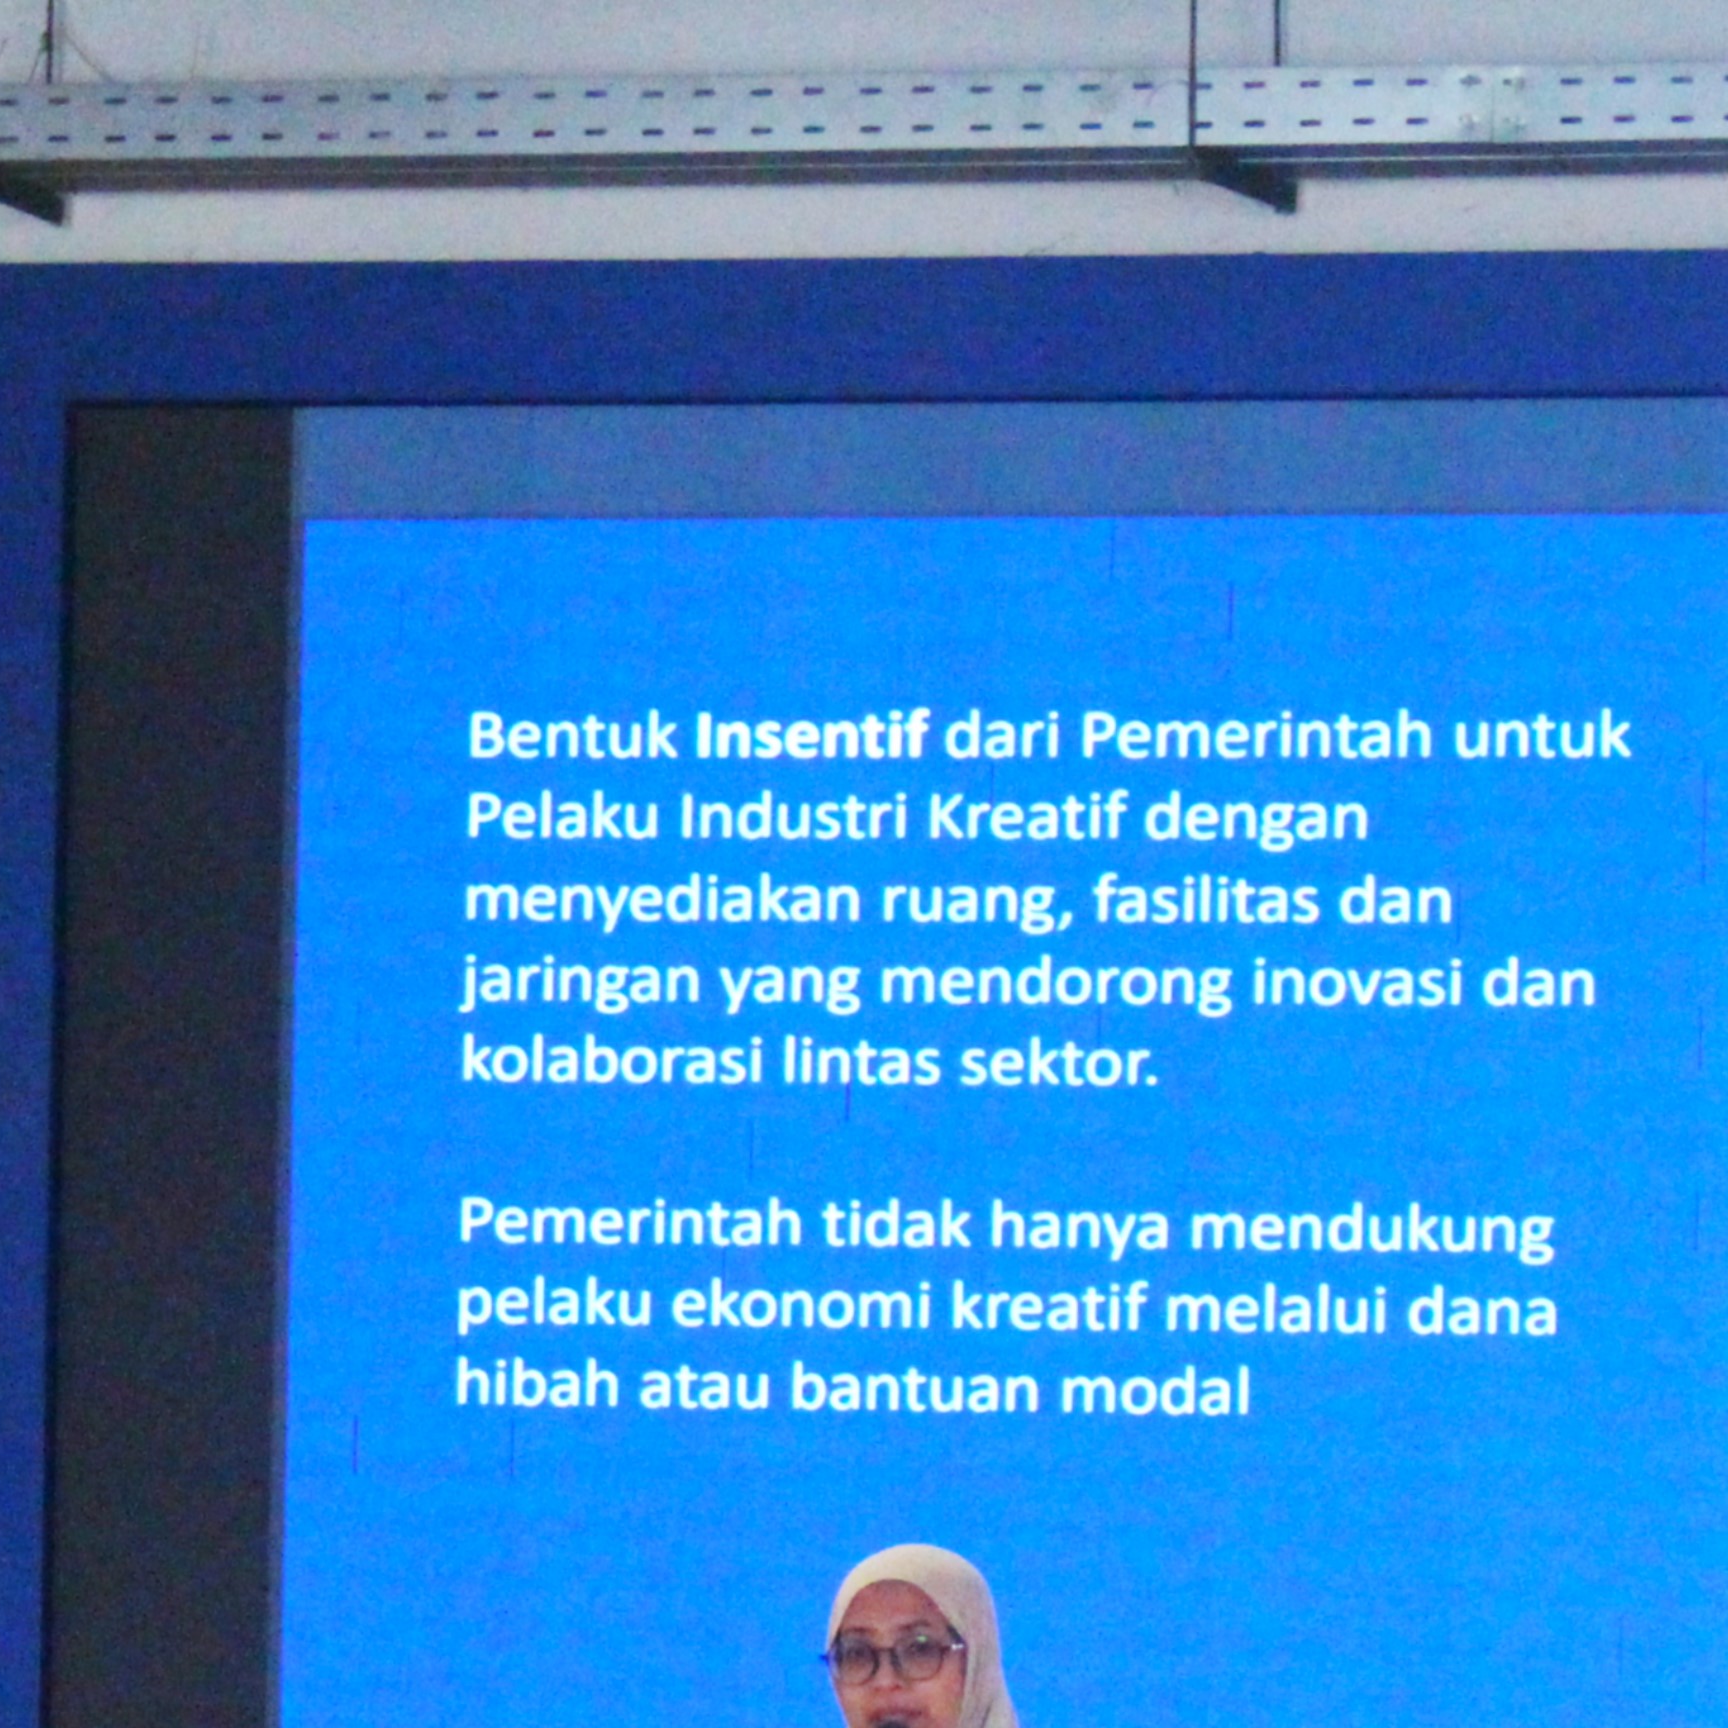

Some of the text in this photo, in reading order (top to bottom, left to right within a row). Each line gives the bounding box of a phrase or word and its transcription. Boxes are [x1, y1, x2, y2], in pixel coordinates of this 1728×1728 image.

[470, 707, 1632, 760] Bentuk Insentif dari Pemerintah untuk
[469, 788, 1368, 853] Pelaku Industri Kreatif dengan
[466, 872, 1452, 935] menyediakan ruang, fasilitas dan
[459, 954, 1596, 1019] jaringan yang mendorong inovasi dan
[463, 1033, 1158, 1087] kolaborasi lintas sektor.
[461, 1197, 1556, 1266] Pemerintah tidak hanya mendukung
[458, 1275, 1558, 1337] pelaku ekonomi kreatif melalui dana
[457, 1356, 1250, 1417] hibah atau bantuan modal
